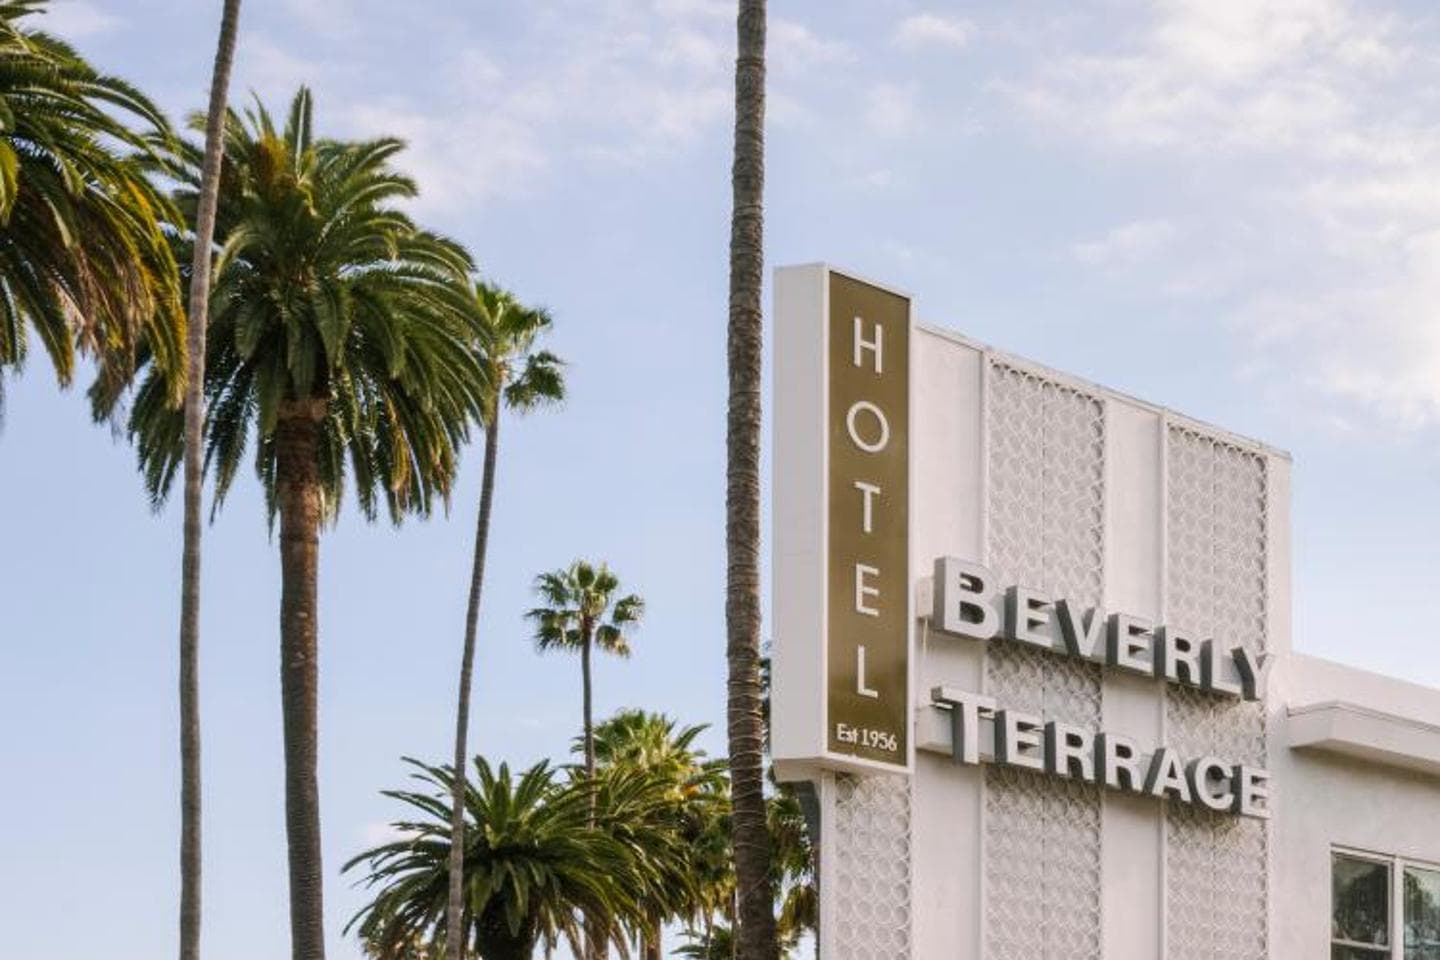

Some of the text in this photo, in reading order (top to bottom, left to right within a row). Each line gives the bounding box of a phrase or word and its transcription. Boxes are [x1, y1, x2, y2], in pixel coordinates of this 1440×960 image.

[847, 317, 890, 699] HOTEL
[934, 556, 1275, 700] BEVERLY
[836, 723, 898, 752] Est 1956
[931, 686, 1273, 819] TERRACE
